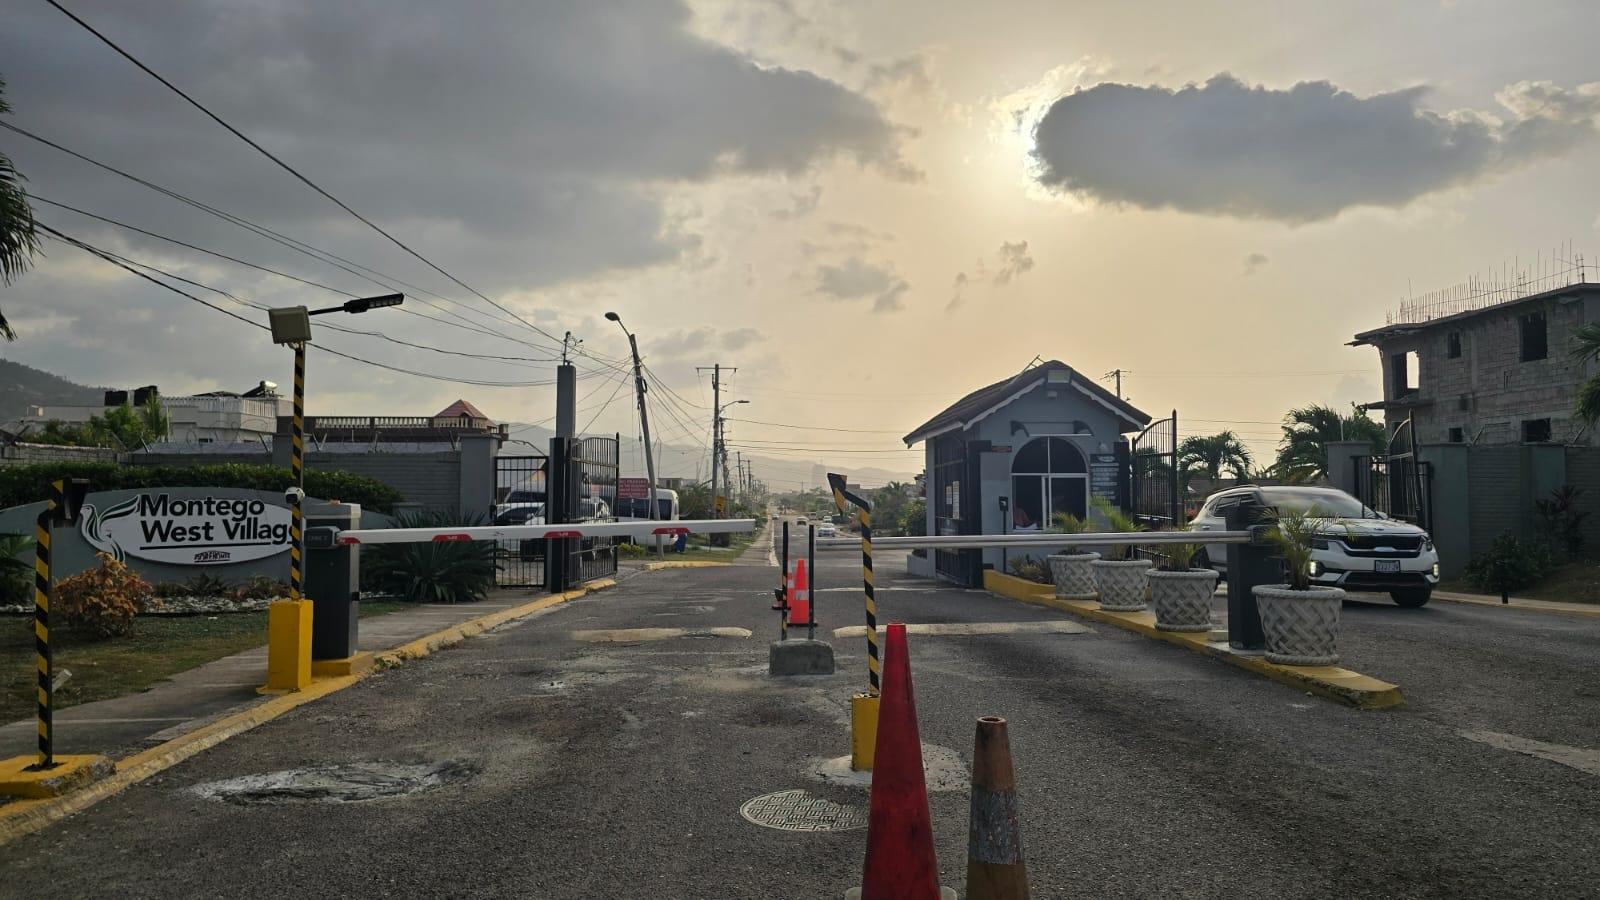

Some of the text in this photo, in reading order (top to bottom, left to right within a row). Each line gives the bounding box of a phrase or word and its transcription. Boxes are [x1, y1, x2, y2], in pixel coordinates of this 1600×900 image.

[140, 494, 265, 522] Montego
[140, 517, 293, 545] West Villag
